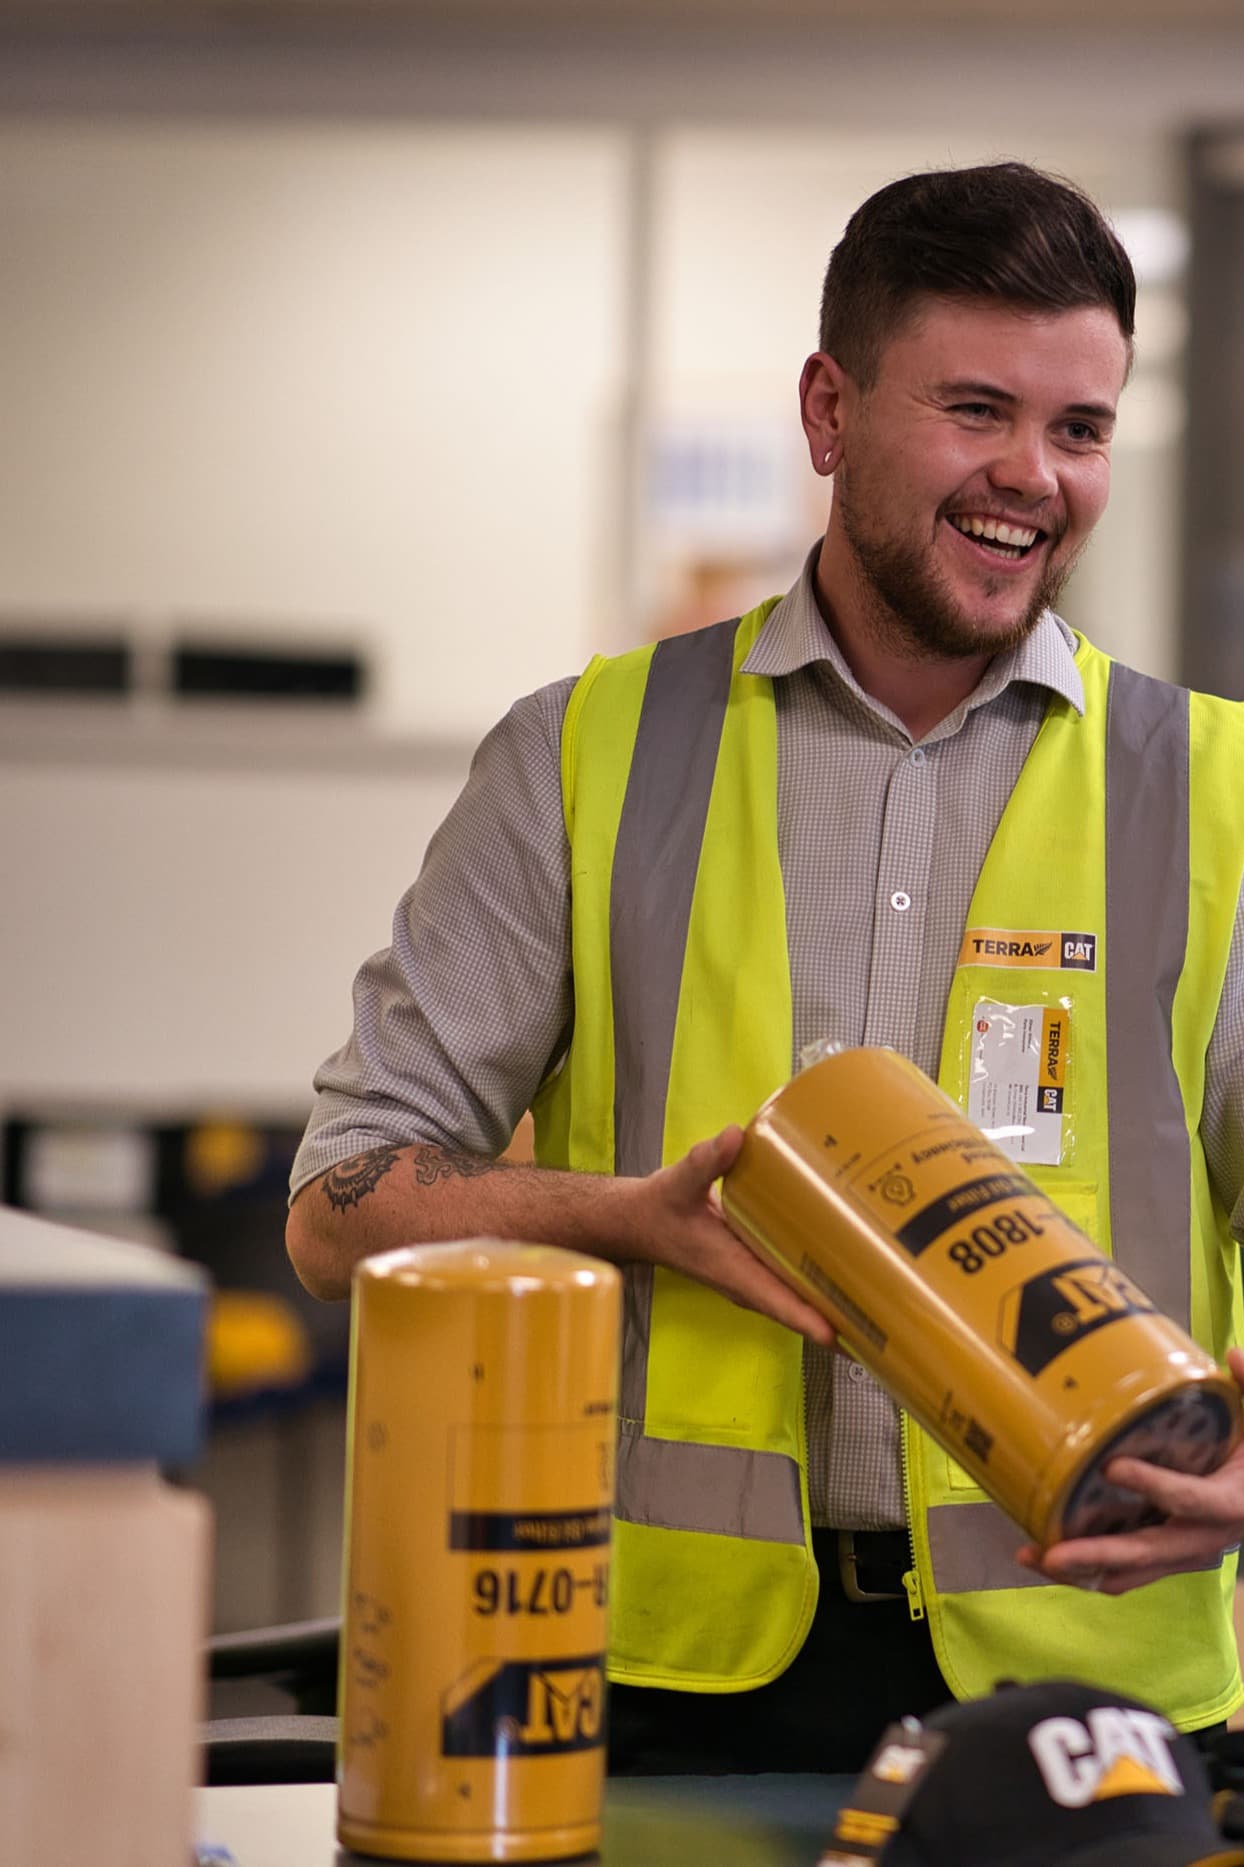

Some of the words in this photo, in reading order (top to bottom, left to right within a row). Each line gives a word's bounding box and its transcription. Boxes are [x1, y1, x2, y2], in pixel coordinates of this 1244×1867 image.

[973, 939, 1034, 957] TERRA
[1064, 941, 1093, 961] CAT
[1047, 1021, 1061, 1068] TERRA
[1042, 1089, 1057, 1111] CAT
[519, 1666, 602, 1745] CAT
[1029, 1706, 1185, 1808] CAT
